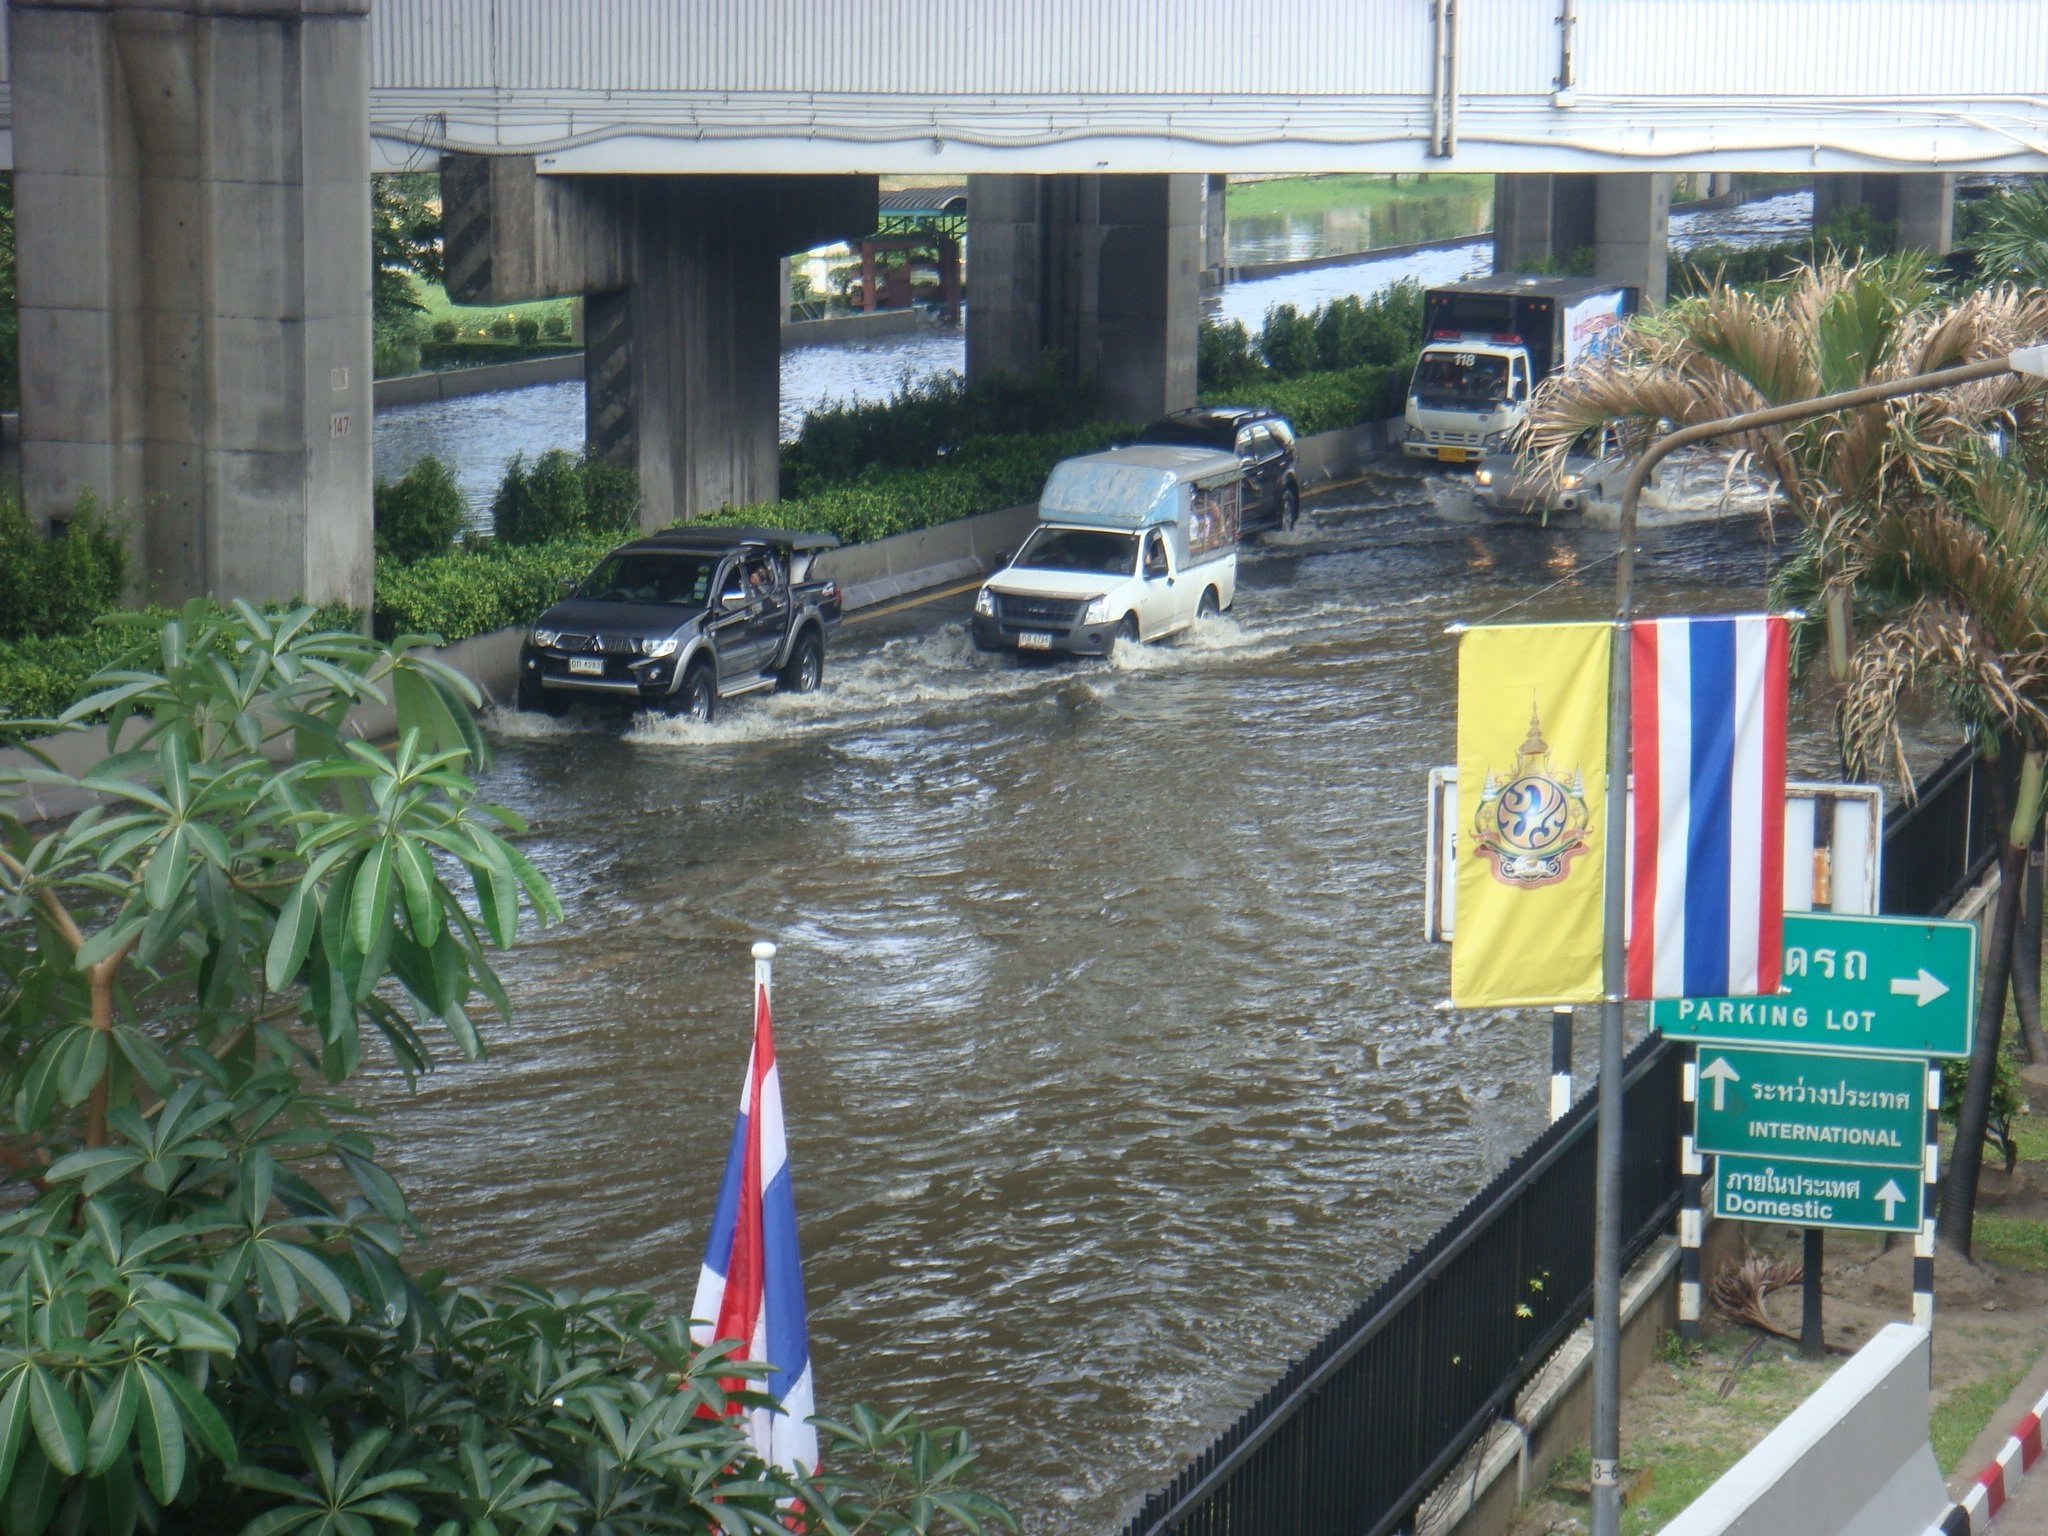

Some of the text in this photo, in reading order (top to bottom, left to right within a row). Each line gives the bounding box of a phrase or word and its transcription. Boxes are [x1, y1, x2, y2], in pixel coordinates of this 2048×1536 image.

[1454, 353, 1476, 367] 118
[333, 416, 350, 436] 147
[1784, 946, 1868, 981] ดรถ
[1679, 999, 1877, 1032] PARKING LOT
[1751, 1077, 1910, 1110] ระหว่างประเทศ
[1749, 1121, 1902, 1147] INTERNATIONAL
[1726, 1167, 1861, 1199] ภายในประเทศ
[1725, 1193, 1833, 1220] Domestic
